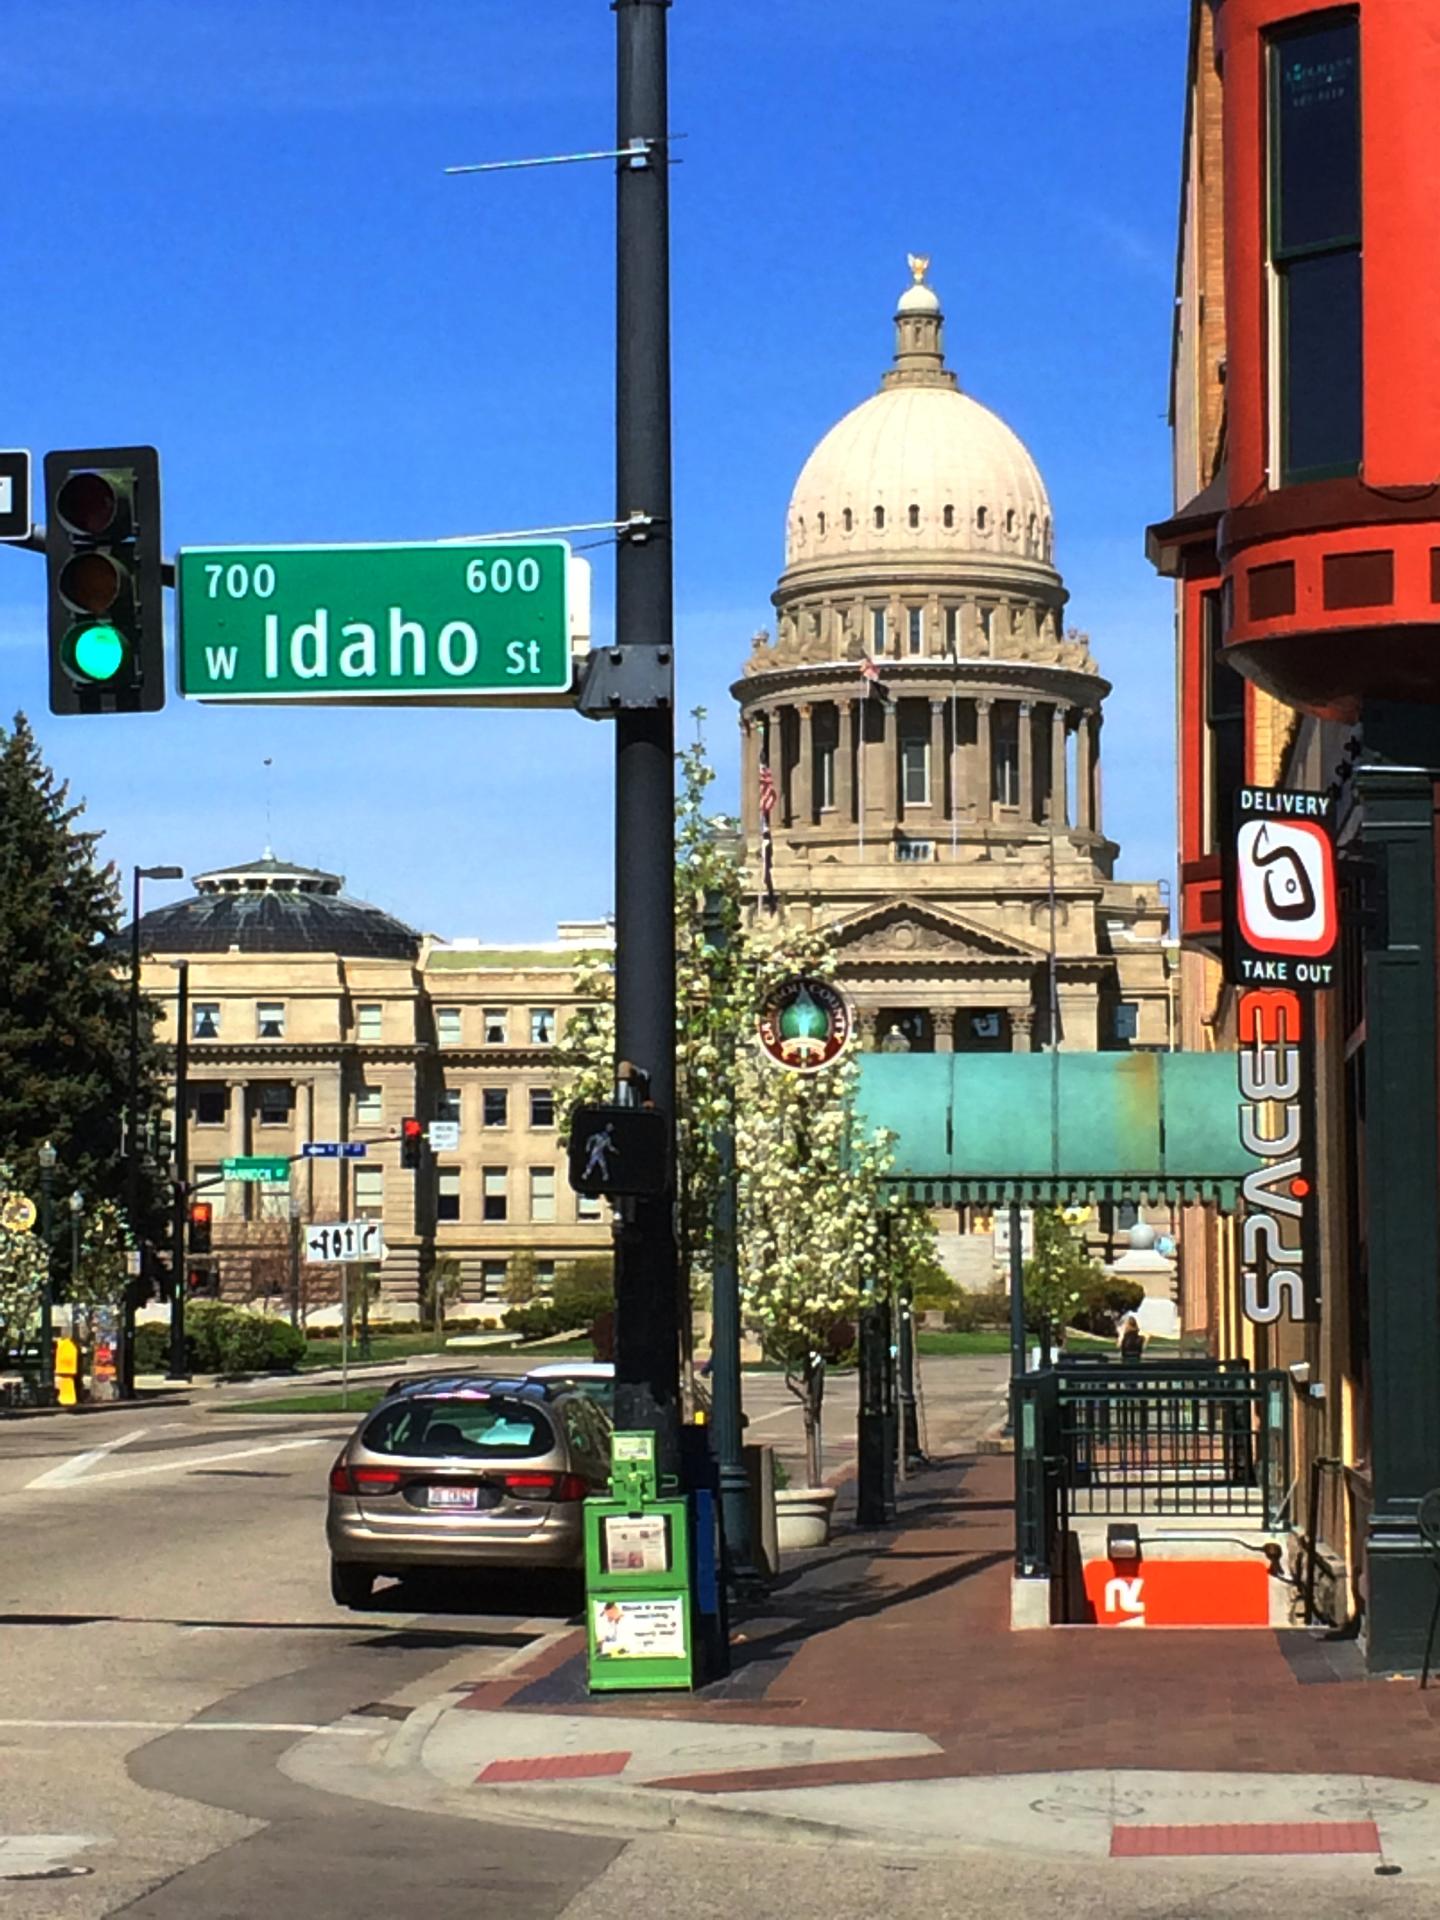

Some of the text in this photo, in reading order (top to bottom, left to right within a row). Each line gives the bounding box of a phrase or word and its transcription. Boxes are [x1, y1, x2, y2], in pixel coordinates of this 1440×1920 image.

[204, 563, 276, 598] 700
[466, 558, 540, 593] 600
[205, 607, 541, 680] W Idaho St
[1241, 791, 1330, 815] DELIVERY
[1242, 961, 1332, 983] TAKE OUT
